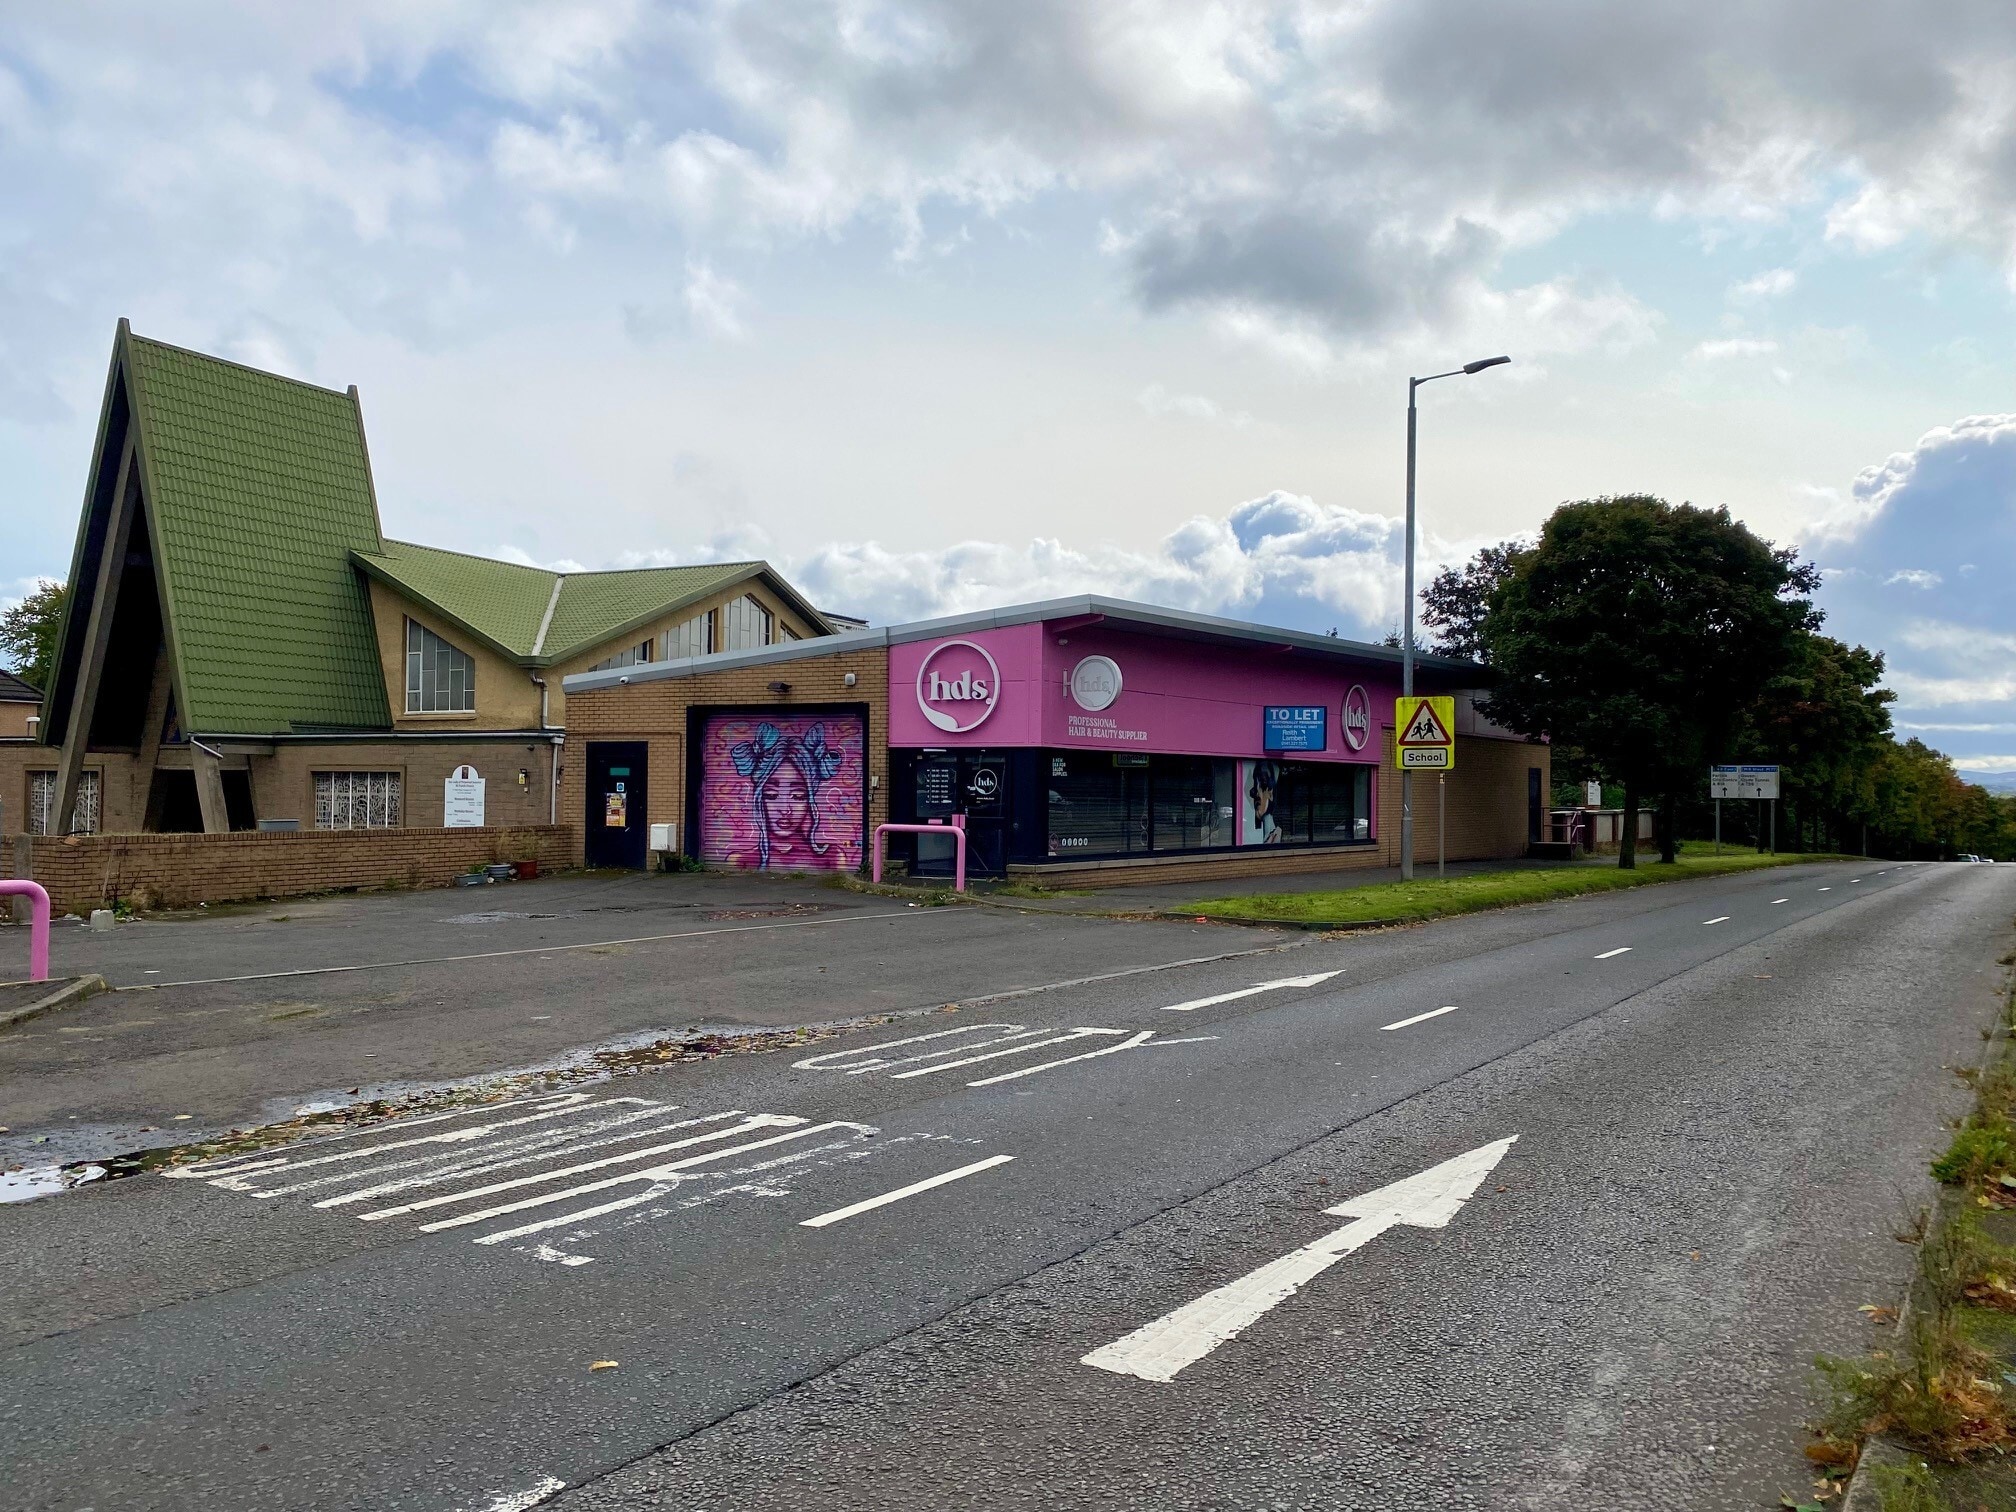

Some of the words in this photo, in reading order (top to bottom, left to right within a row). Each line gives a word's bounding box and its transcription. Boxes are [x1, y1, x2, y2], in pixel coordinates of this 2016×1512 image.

[1068, 715, 1117, 728] PROFESSIONAL
[1270, 709, 1290, 720] TO
[1294, 709, 1320, 721] LET
[1068, 726, 1086, 737] HAIR
[1087, 727, 1092, 737] &
[1093, 728, 1118, 739] BEAUTY
[1118, 730, 1148, 741] SUPPLIER
[1408, 753, 1443, 762] School
[791, 1023, 1219, 1087] CITY
[162, 1092, 982, 1267] CENTRE
